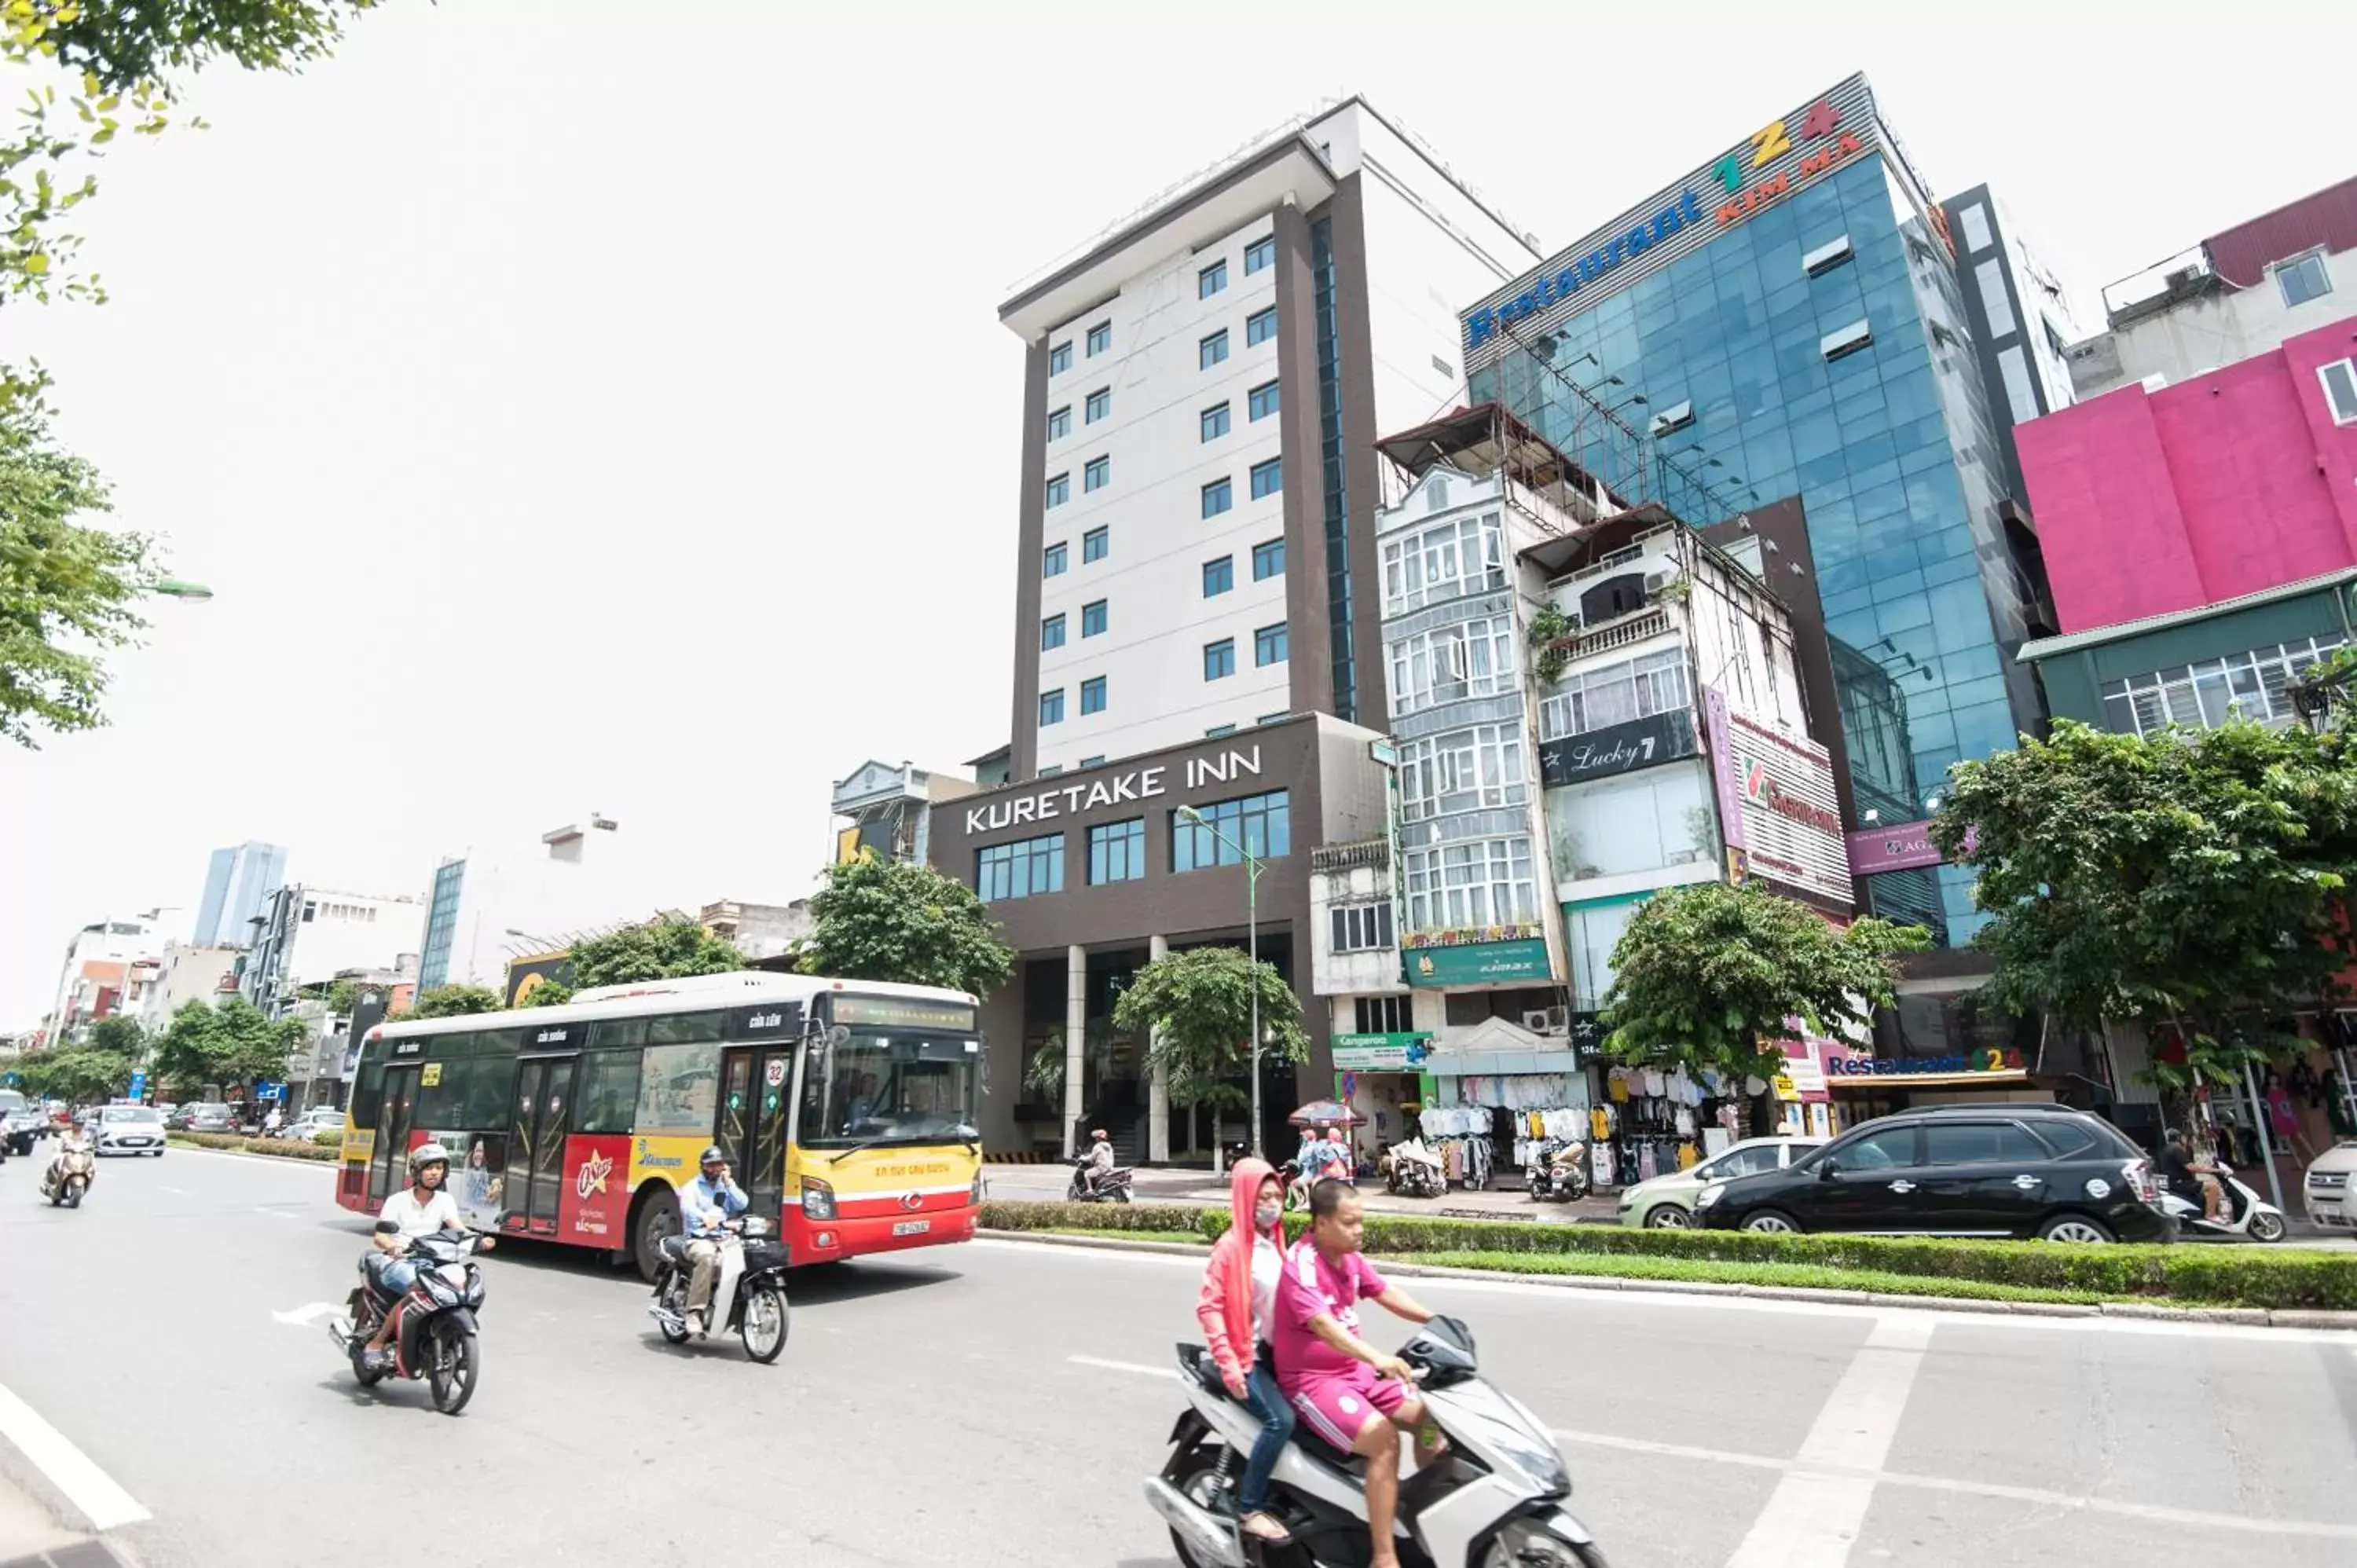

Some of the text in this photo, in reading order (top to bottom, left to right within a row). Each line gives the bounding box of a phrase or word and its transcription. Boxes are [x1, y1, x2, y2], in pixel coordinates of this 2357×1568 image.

[1715, 129, 1862, 226] KIM MA
[1464, 185, 1703, 348] Restaurant
[965, 745, 1260, 834] KURETAKE INN
[1571, 739, 1639, 772] Lucky
[770, 1066, 782, 1080] 32
